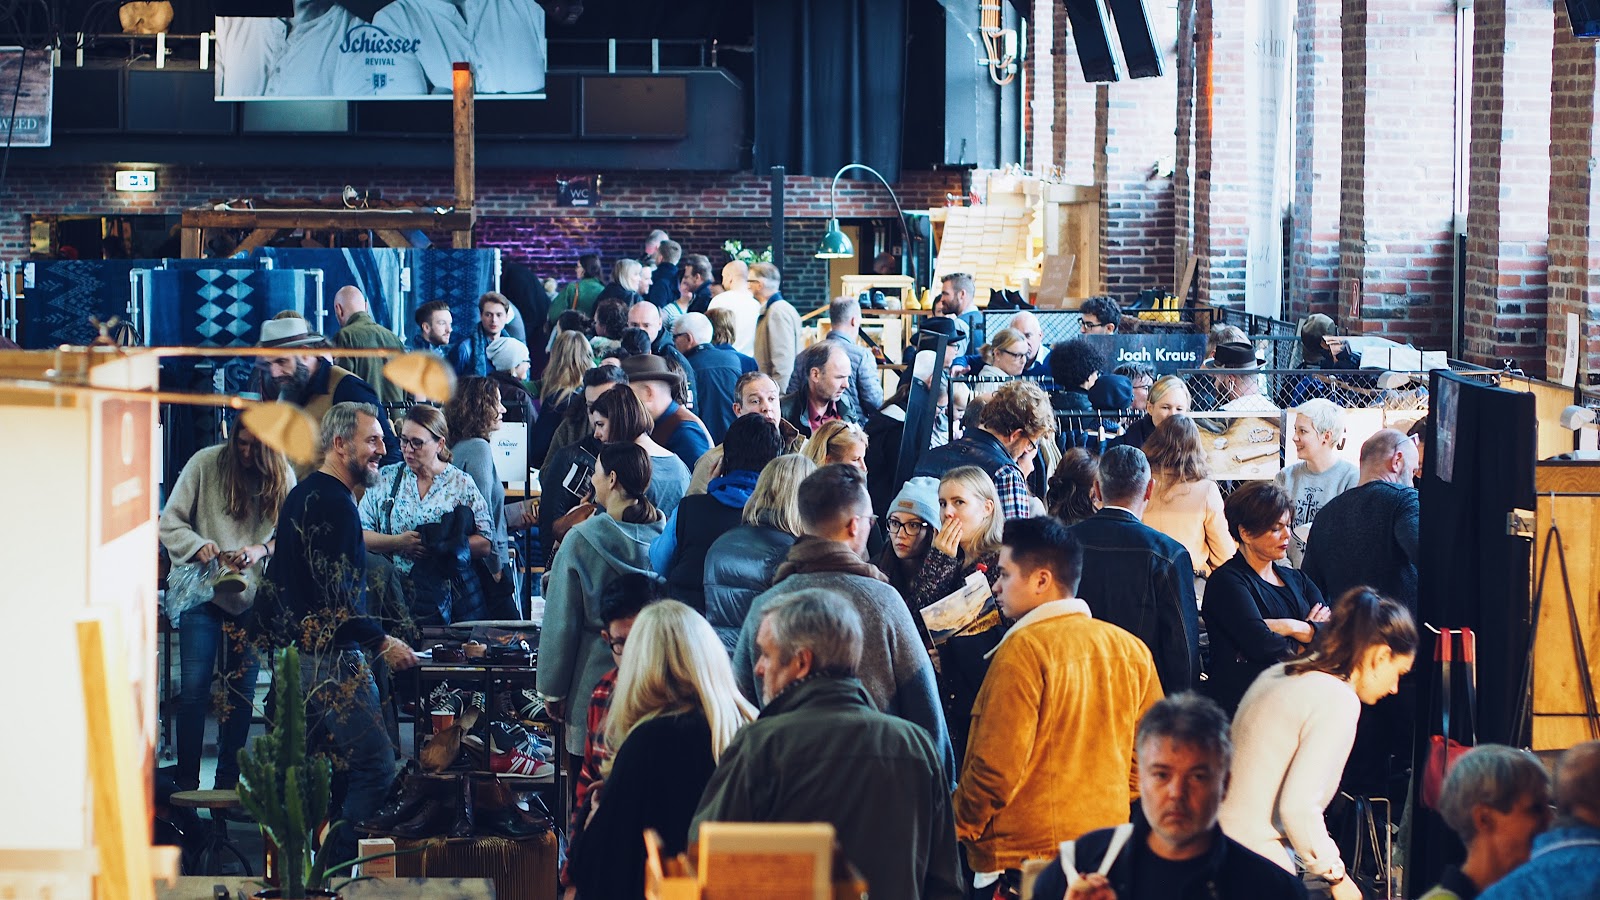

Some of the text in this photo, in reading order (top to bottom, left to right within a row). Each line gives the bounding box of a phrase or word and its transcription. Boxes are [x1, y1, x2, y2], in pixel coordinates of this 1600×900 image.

[339, 24, 421, 53] Schiesser
[365, 58, 396, 66] REVIVAL
[570, 189, 589, 199] WC
[1117, 346, 1197, 362] Joah Kraus
